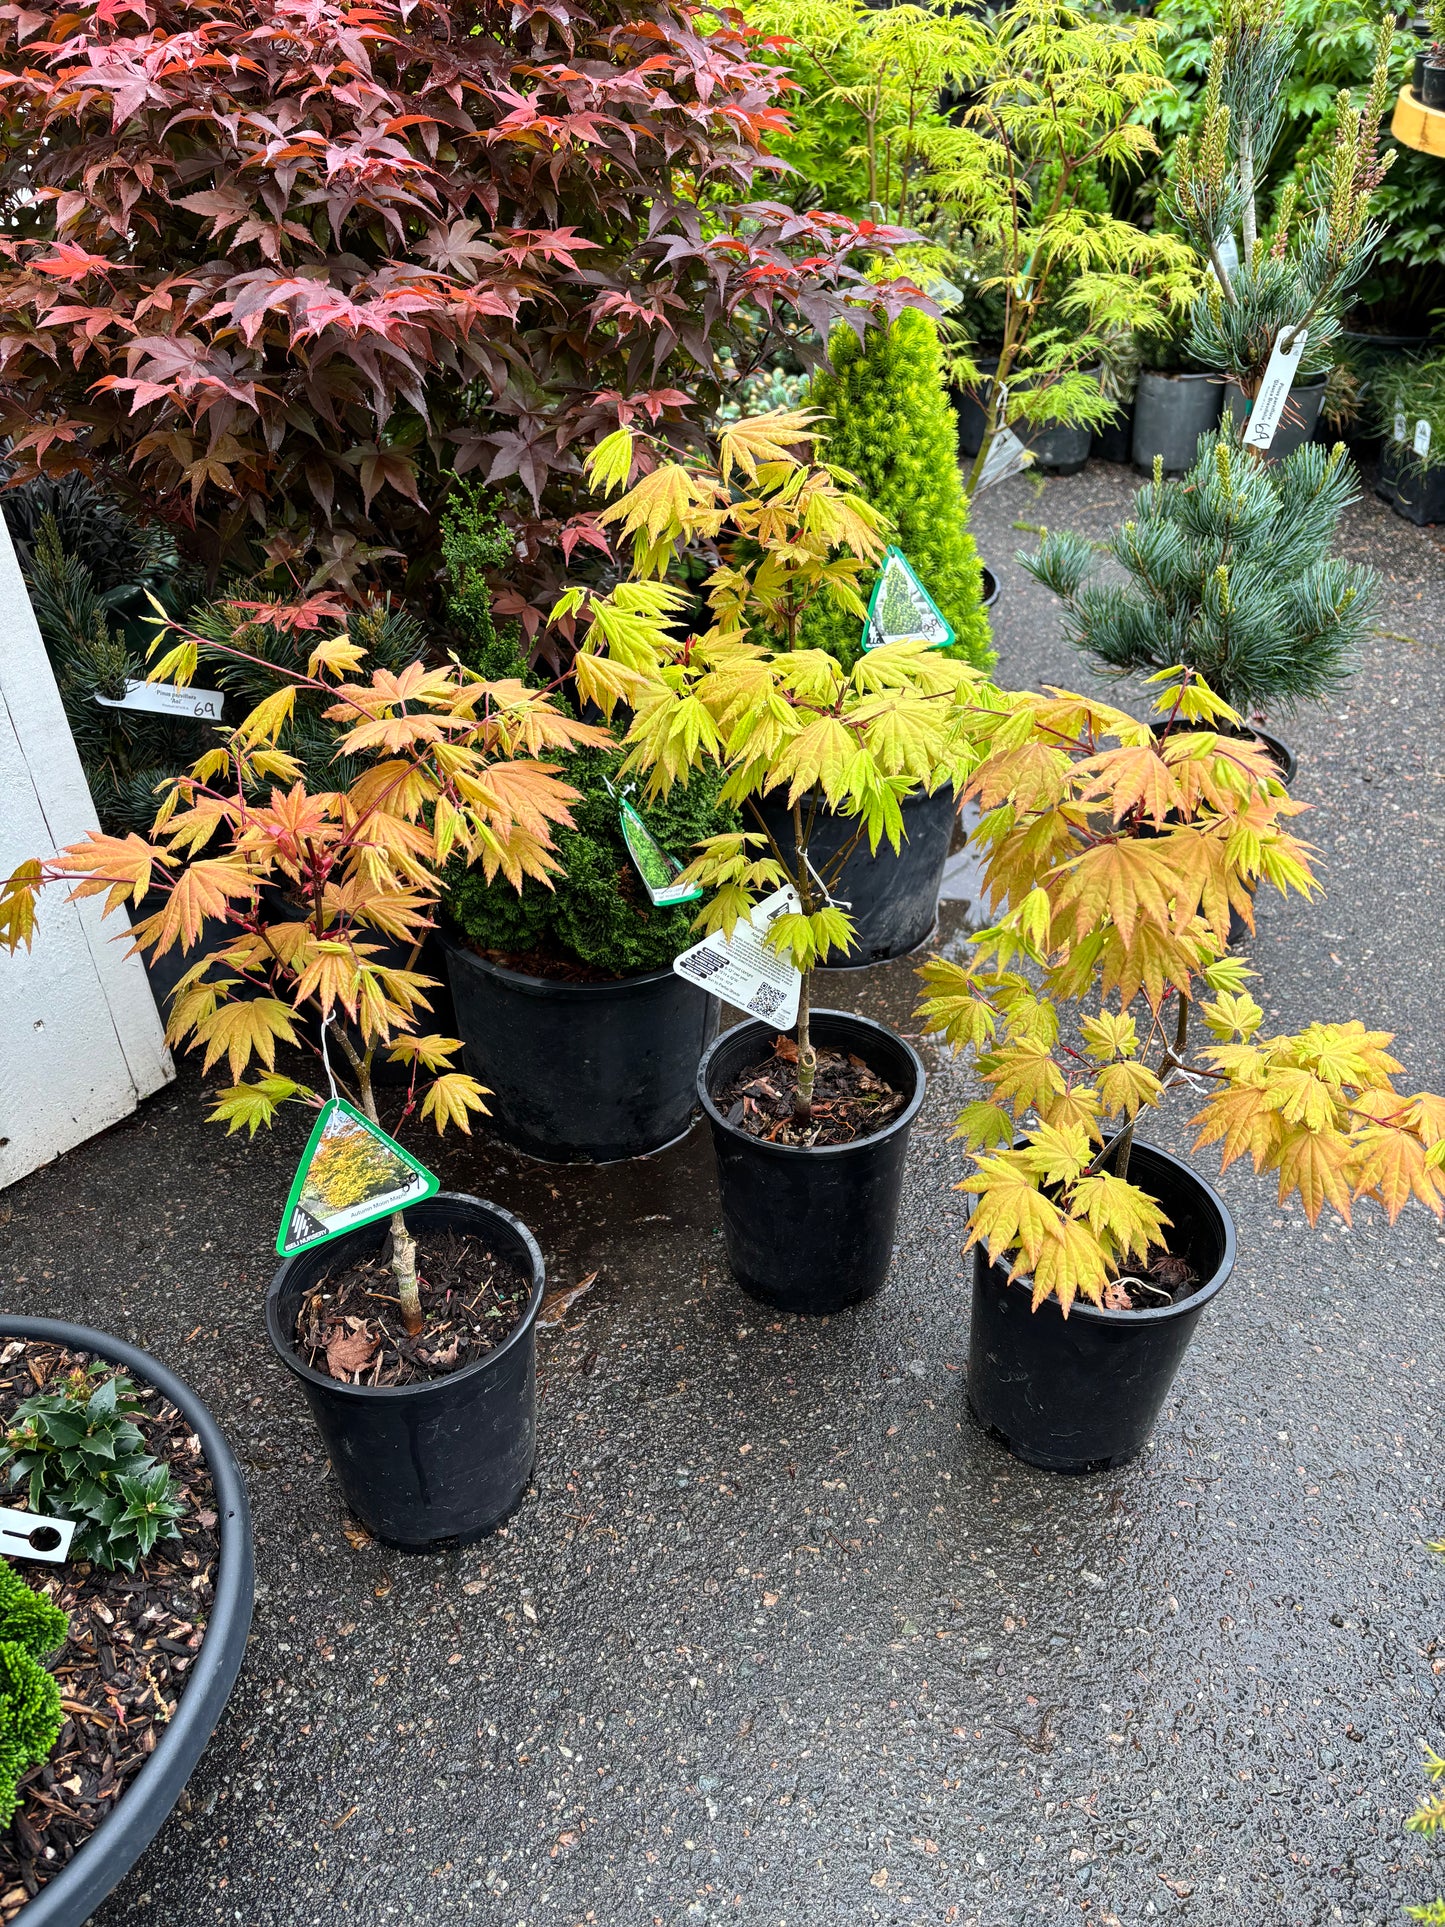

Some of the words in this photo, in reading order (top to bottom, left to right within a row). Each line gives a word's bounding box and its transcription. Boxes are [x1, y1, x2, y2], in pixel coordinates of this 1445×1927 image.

[1276, 382, 1284, 396] Pinus
[1252, 423, 1270, 441] 69
[194, 702, 215, 717] 69
[351, 1206, 372, 1218] Autumn
[373, 1199, 390, 1208] Moon
